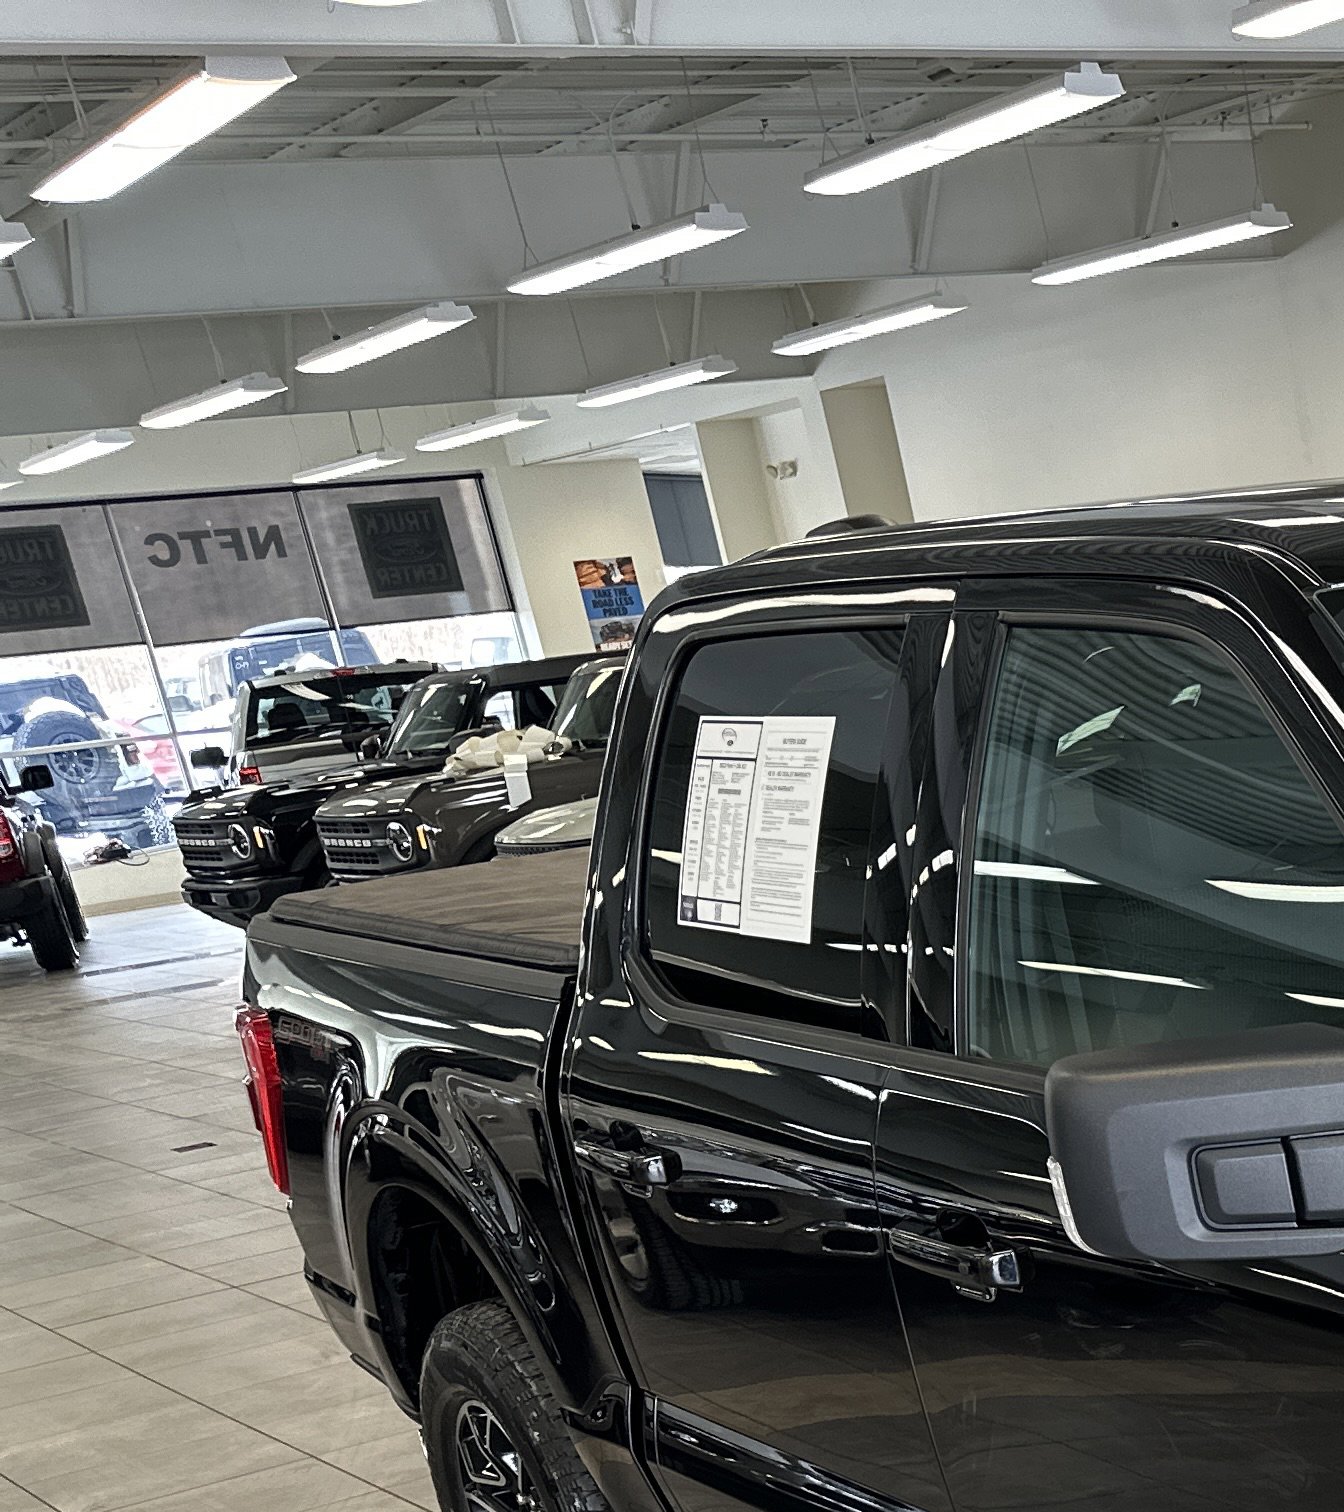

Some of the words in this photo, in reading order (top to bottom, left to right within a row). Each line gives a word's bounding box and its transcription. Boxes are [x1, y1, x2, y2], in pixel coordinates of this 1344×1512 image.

[592, 588, 612, 599] TAKE
[613, 587, 630, 598] THE
[323, 838, 371, 847] BRONCO
